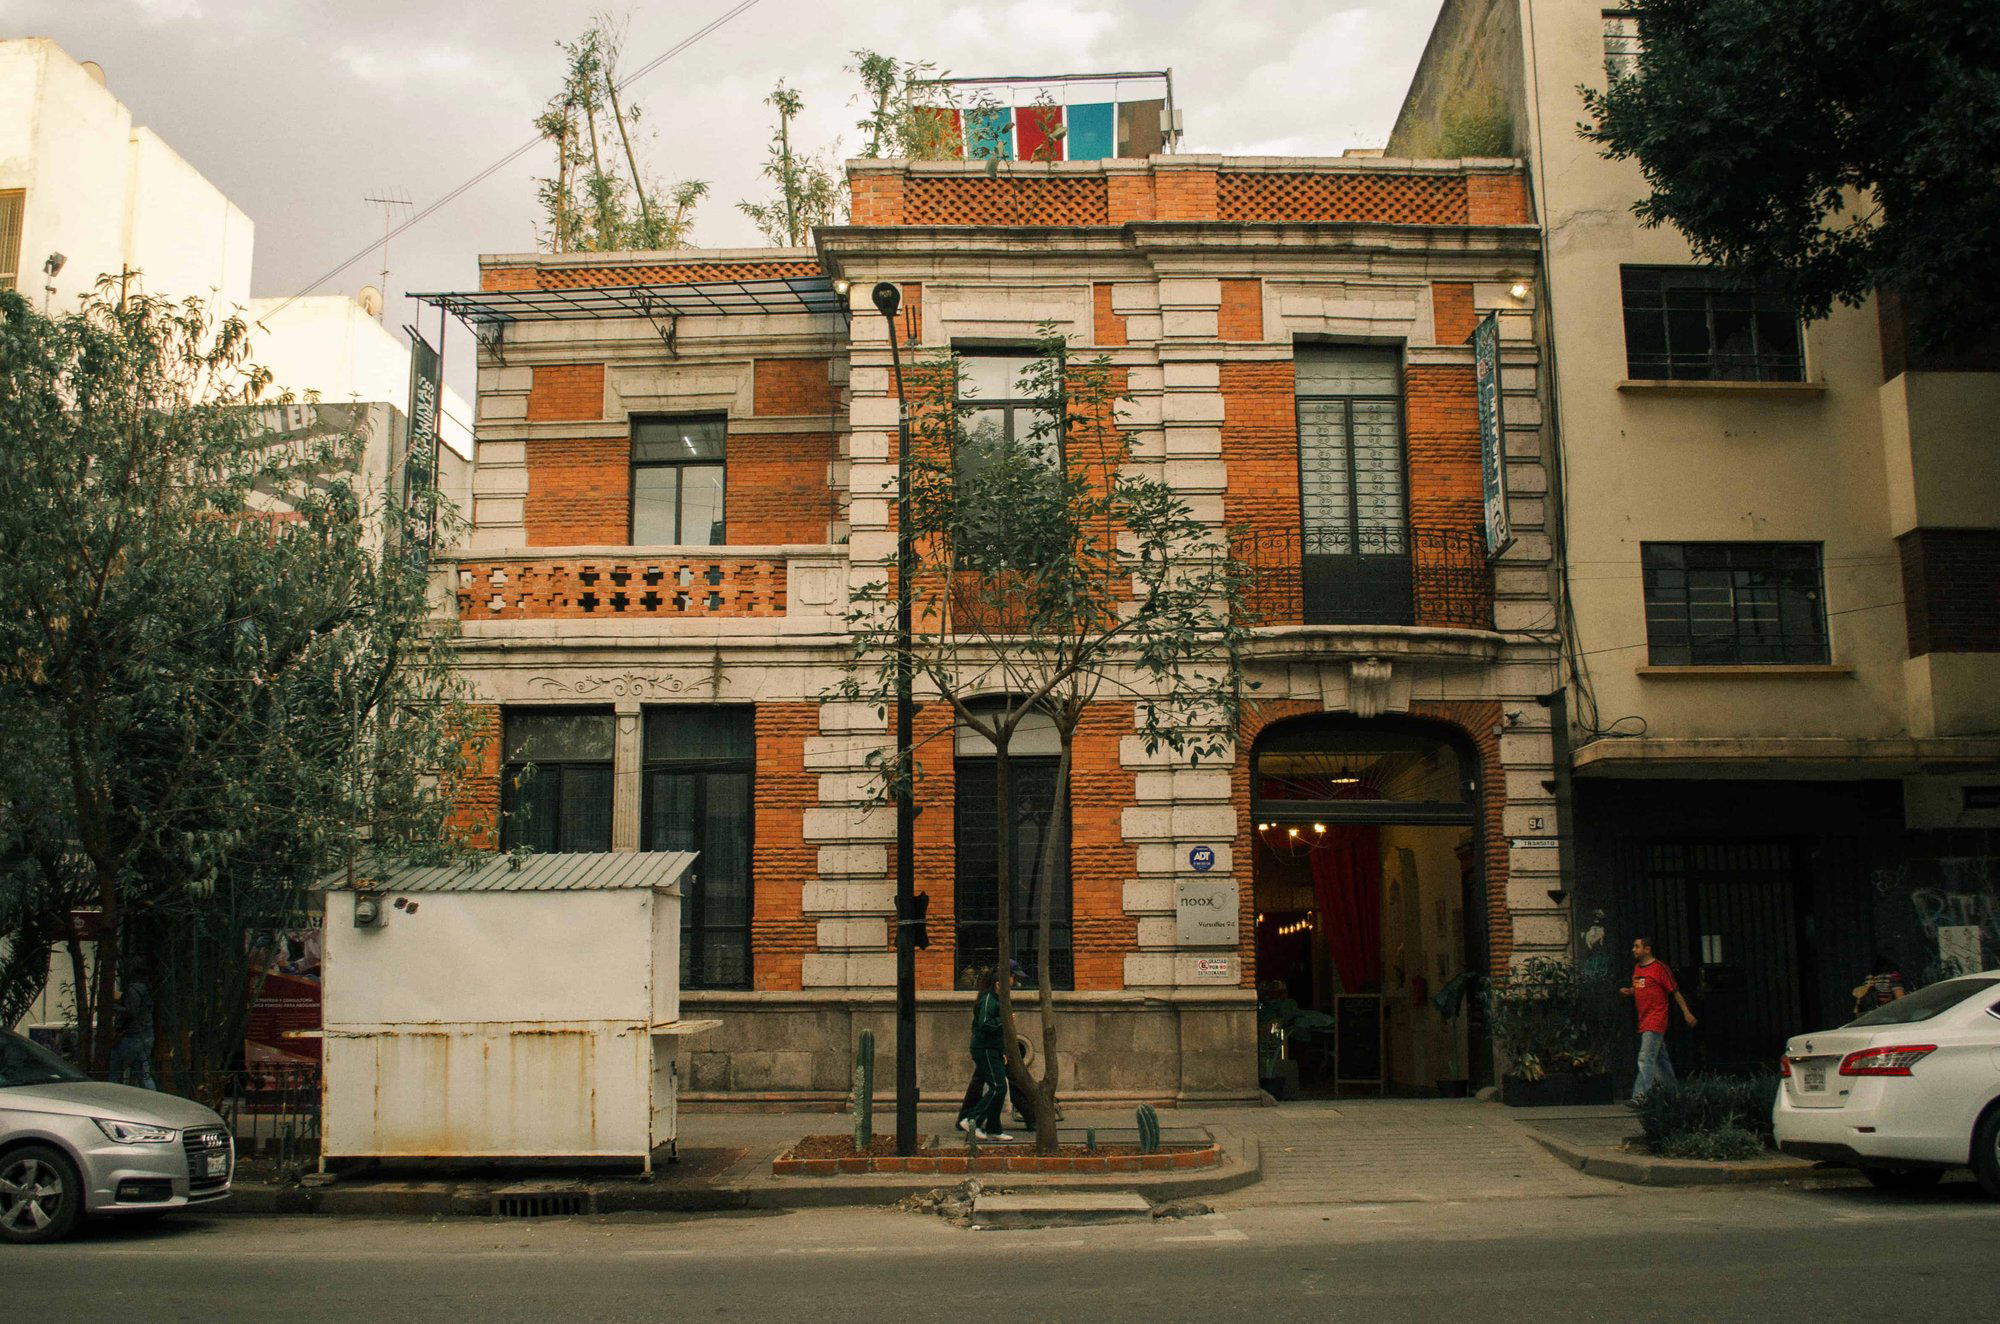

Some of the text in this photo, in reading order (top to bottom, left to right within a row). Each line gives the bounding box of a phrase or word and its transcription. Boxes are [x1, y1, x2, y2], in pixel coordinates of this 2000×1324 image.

[1529, 818, 1543, 829] 94
[1193, 852, 1211, 861] ADT
[1180, 897, 1214, 907] noox
